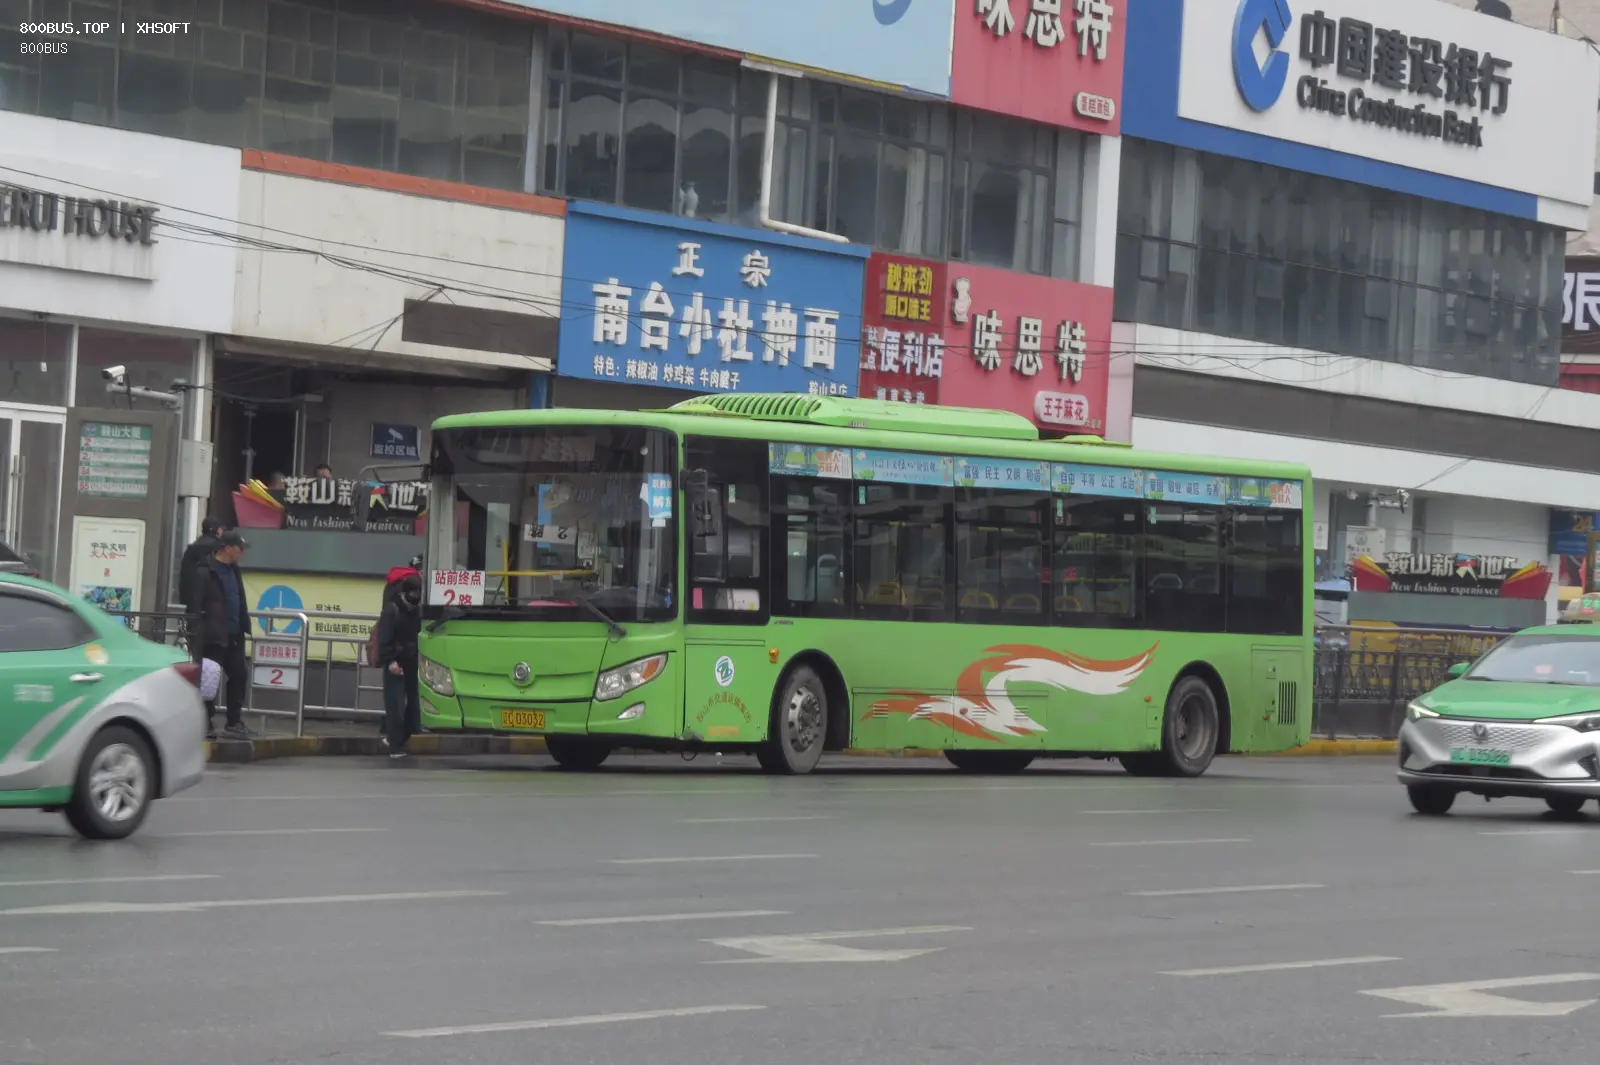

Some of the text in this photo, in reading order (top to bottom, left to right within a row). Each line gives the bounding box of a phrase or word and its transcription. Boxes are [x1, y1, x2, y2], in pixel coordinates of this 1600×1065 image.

[1299, 10, 1512, 114] 中国建设银行
[1296, 75, 1483, 147] China Construction Bank
[63, 196, 160, 244] HOUSE
[879, 327, 945, 378] 便利店
[972, 309, 1087, 382] 味思特
[434, 570, 482, 586] 站前终点
[1390, 582, 1411, 591] New
[1414, 582, 1447, 593] fashion
[270, 669, 284, 685] 2
